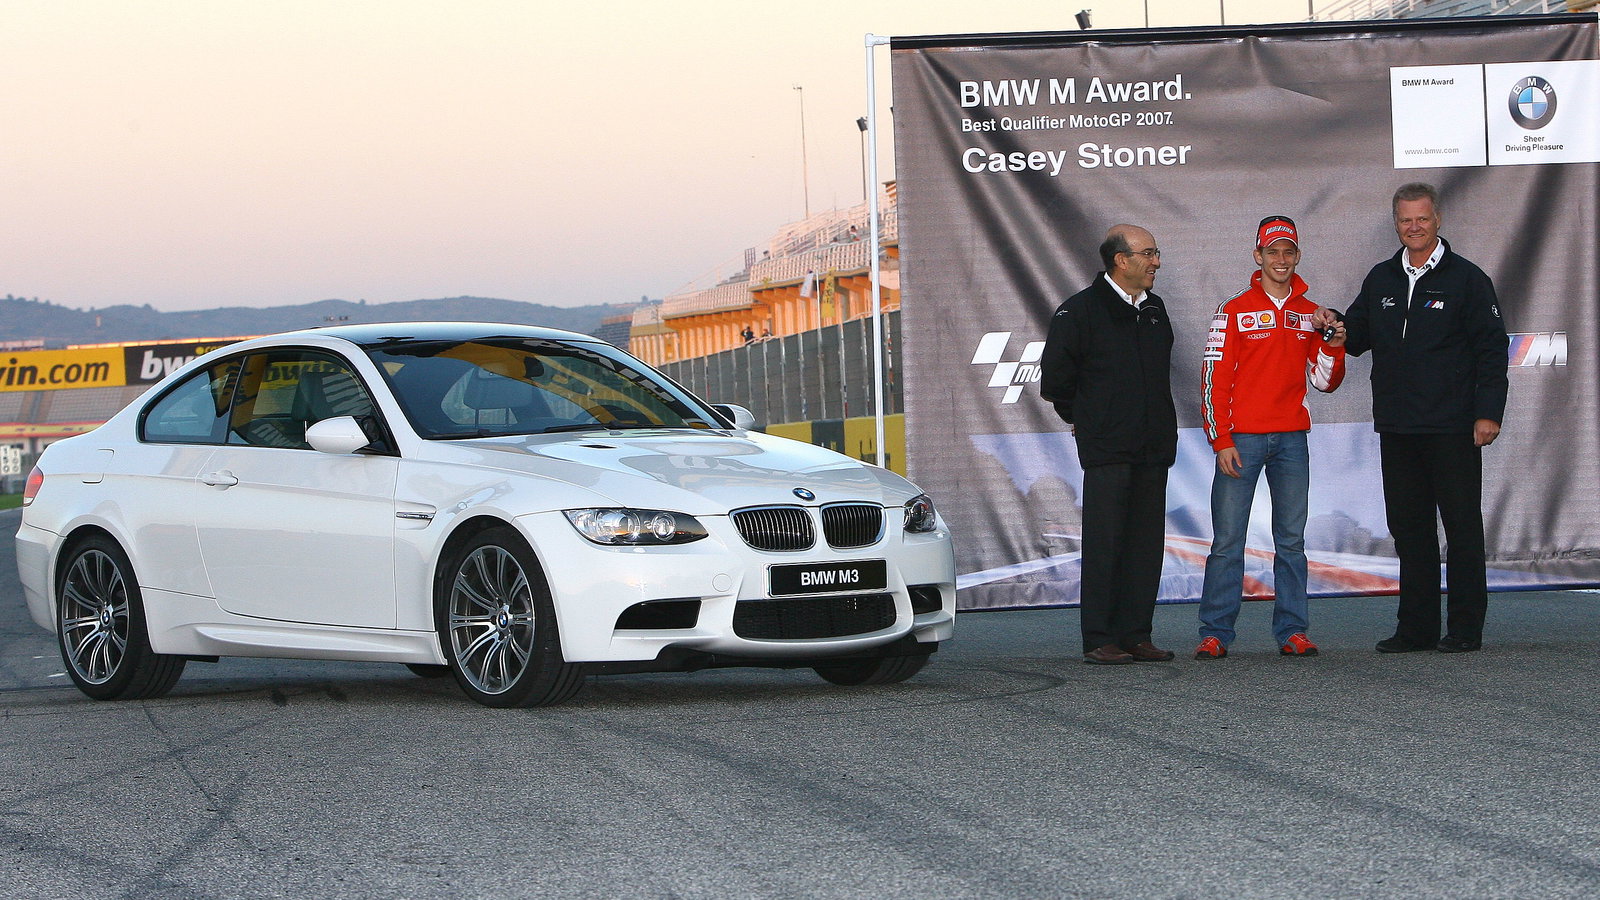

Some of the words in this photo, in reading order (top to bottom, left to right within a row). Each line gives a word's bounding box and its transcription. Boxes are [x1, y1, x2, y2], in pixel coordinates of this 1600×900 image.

[959, 79, 1040, 108] BMW
[1049, 78, 1075, 104] M
[1086, 74, 1192, 103] Award.
[1402, 78, 1422, 87] BMW
[1422, 78, 1430, 86] M
[1431, 78, 1454, 86] Award
[1513, 77, 1552, 94] BMW
[961, 118, 996, 132] Best
[1000, 116, 1066, 132] Qualifier
[1069, 114, 1132, 129] MotoGP
[1136, 112, 1174, 127] 2007.
[1523, 135, 1545, 143] Sheer
[1405, 146, 1459, 155] www.bmw.com
[1505, 144, 1531, 153] Driving
[1532, 143, 1564, 151] Pleasure
[962, 146, 1067, 177] Casey
[1078, 142, 1192, 169] Stoner
[801, 571, 836, 586] BMW
[838, 568, 859, 584] M3
